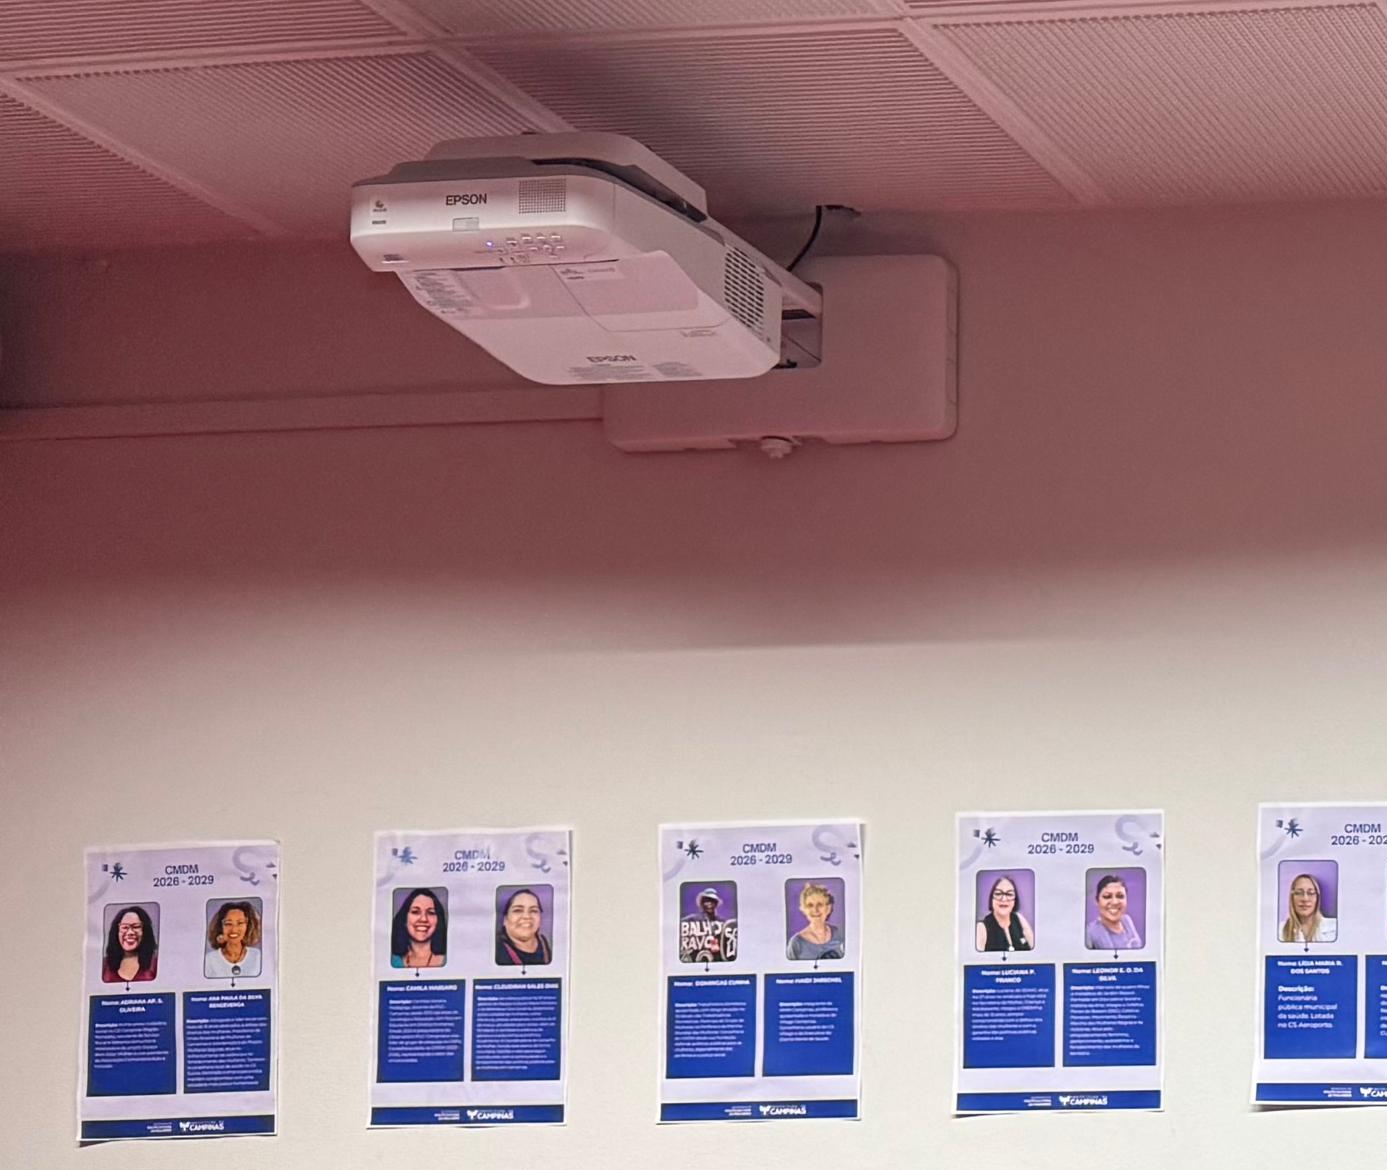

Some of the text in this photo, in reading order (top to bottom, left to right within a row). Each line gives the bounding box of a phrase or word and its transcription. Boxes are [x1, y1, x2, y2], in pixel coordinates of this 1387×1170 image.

[445, 193, 487, 206] EPSON
[587, 354, 636, 363] EPSON
[1344, 823, 1380, 833] CMDM
[1041, 832, 1078, 842] CMDM
[1331, 836, 1359, 845] 2026
[743, 843, 776, 853] CMDM
[1027, 844, 1056, 854] 2026
[1065, 844, 1094, 854] 2029
[454, 850, 490, 860] CMDM
[730, 855, 756, 865] 2026
[765, 853, 792, 864] 2029
[165, 864, 198, 875] CMDM
[443, 863, 468, 873] 2026
[478, 861, 505, 871] 2029
[153, 877, 179, 887] 2026
[188, 875, 214, 885] 2029
[1070, 1097, 1107, 1105] CAMPINAS
[477, 1111, 514, 1120] CAMPINAS
[770, 1107, 806, 1115] CAMPINAS
[190, 1123, 224, 1131] CAMPINAS
